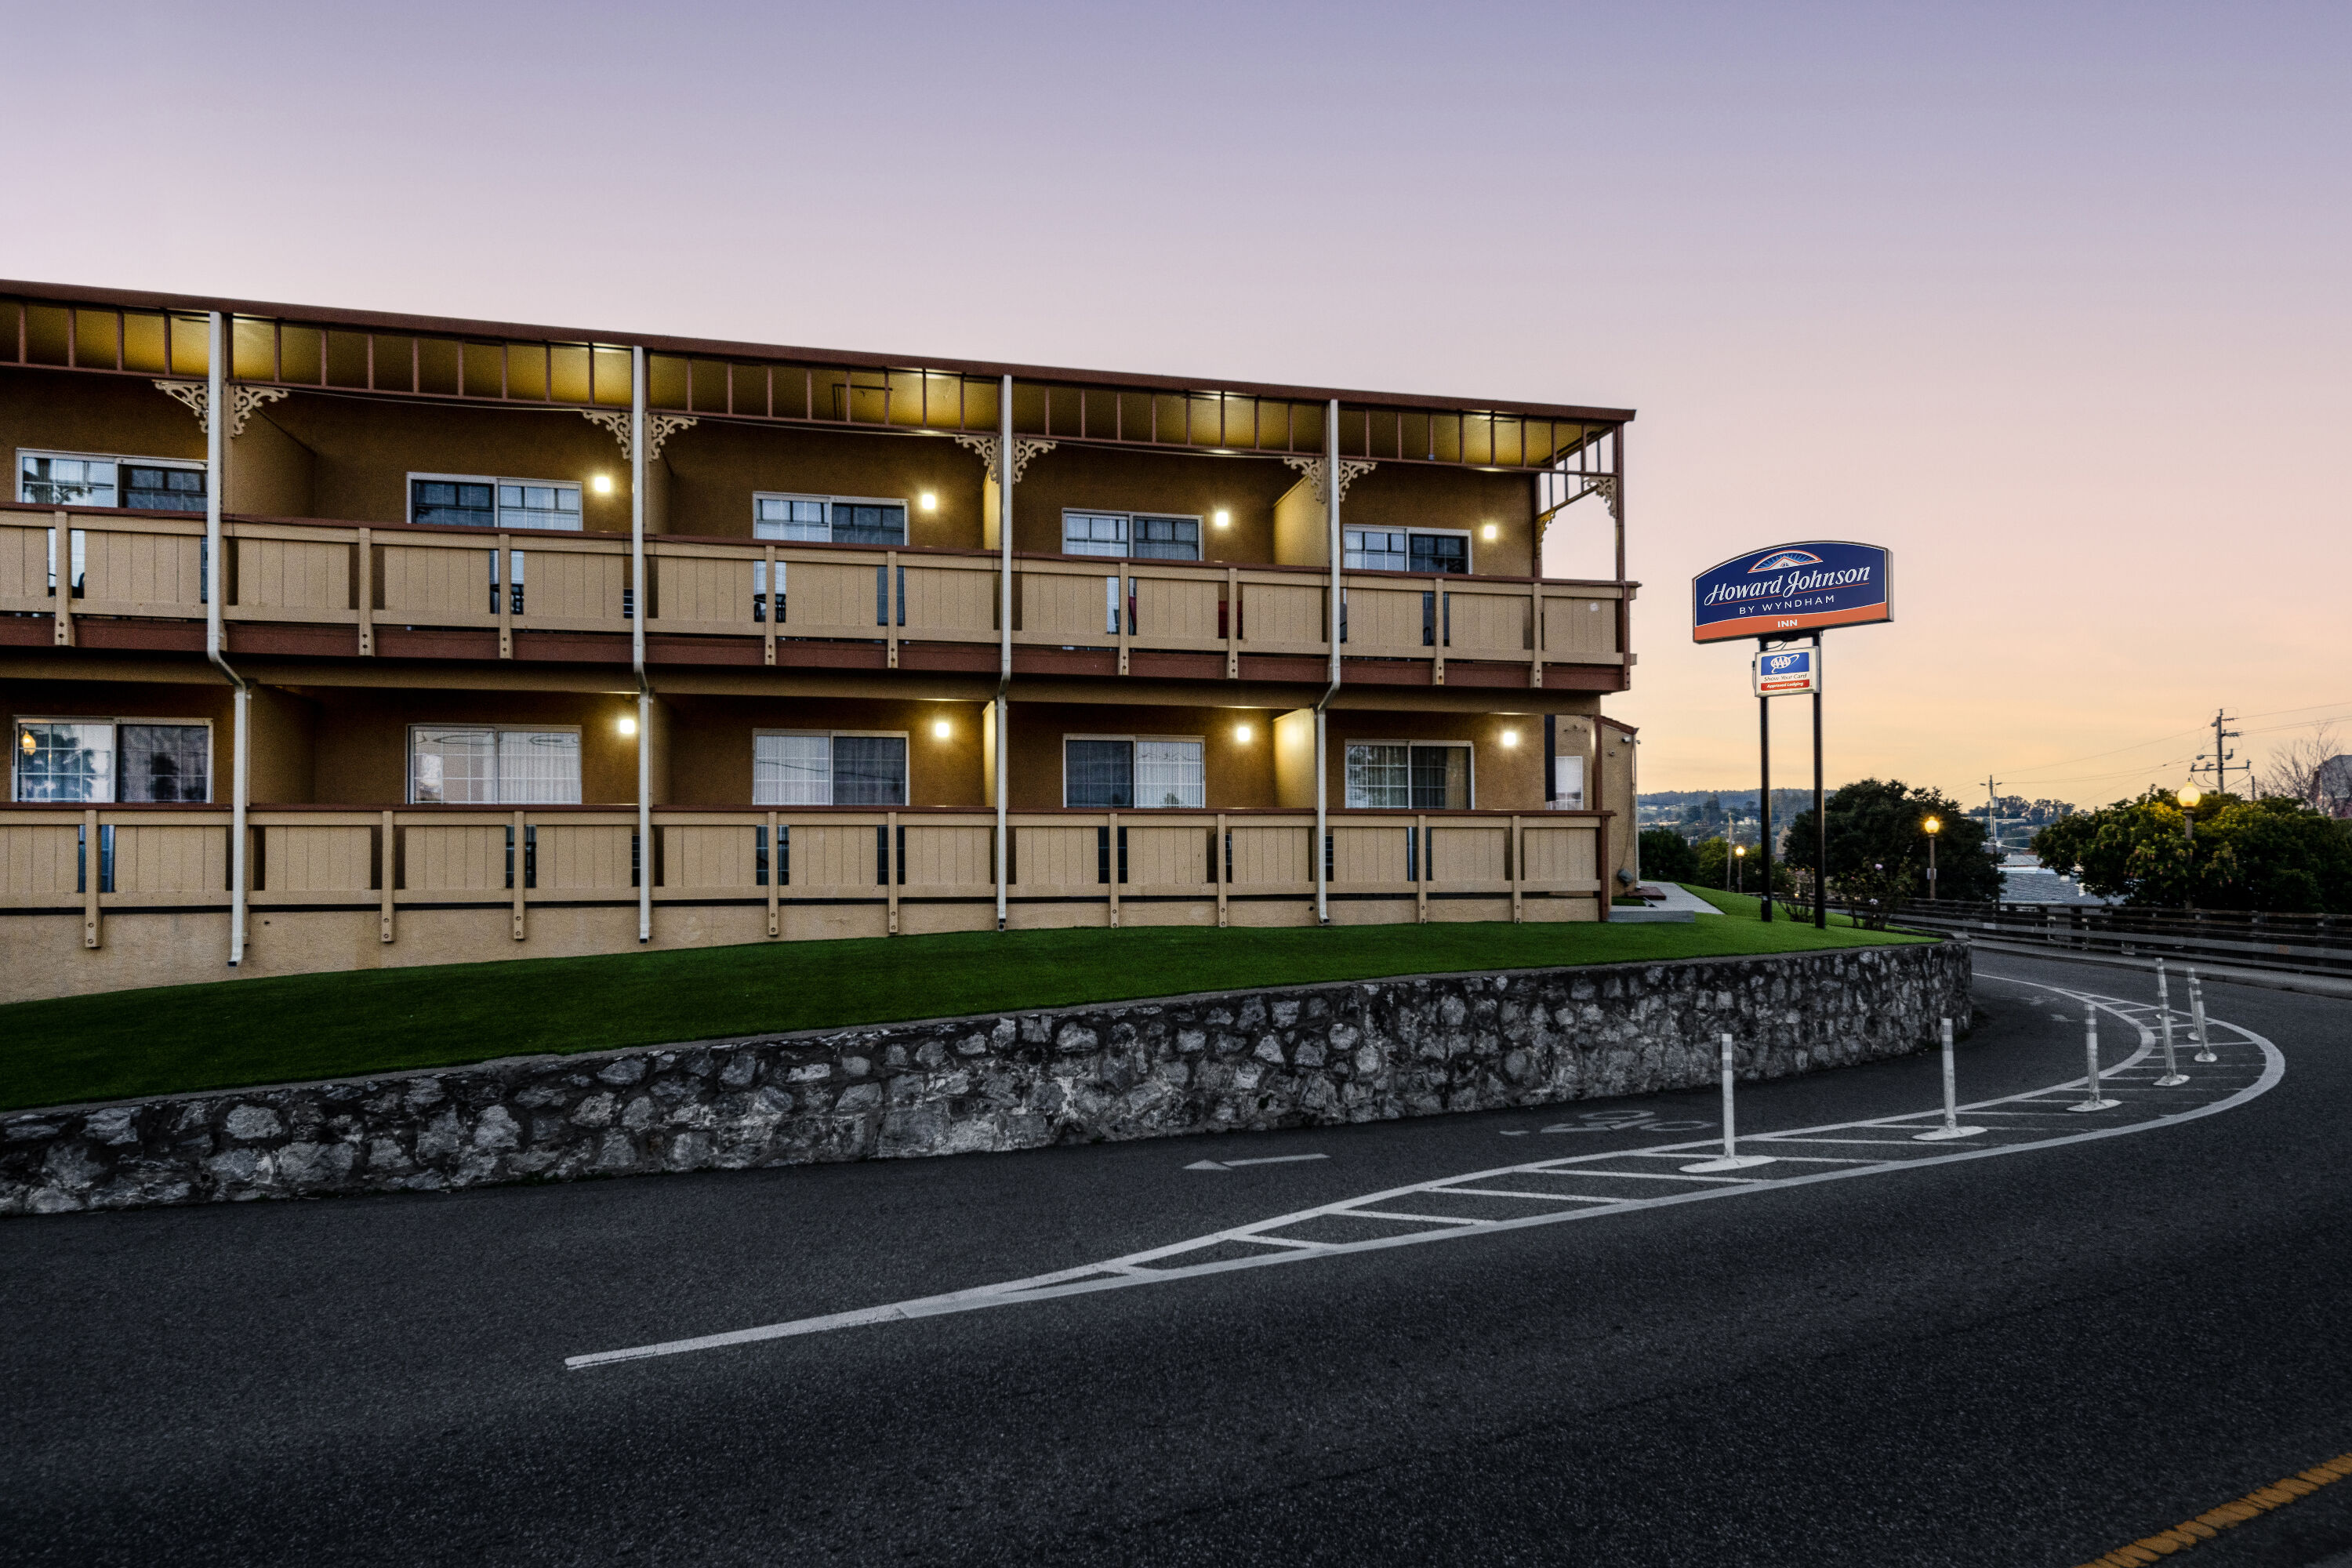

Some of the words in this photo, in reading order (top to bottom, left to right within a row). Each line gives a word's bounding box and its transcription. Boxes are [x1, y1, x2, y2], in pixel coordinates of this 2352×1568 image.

[1704, 575, 1784, 606] Howard
[1782, 566, 1871, 598] Johnson
[1739, 605, 1755, 615] BY
[1762, 594, 1835, 612] WYNDHAM
[1777, 619, 1798, 628] INN
